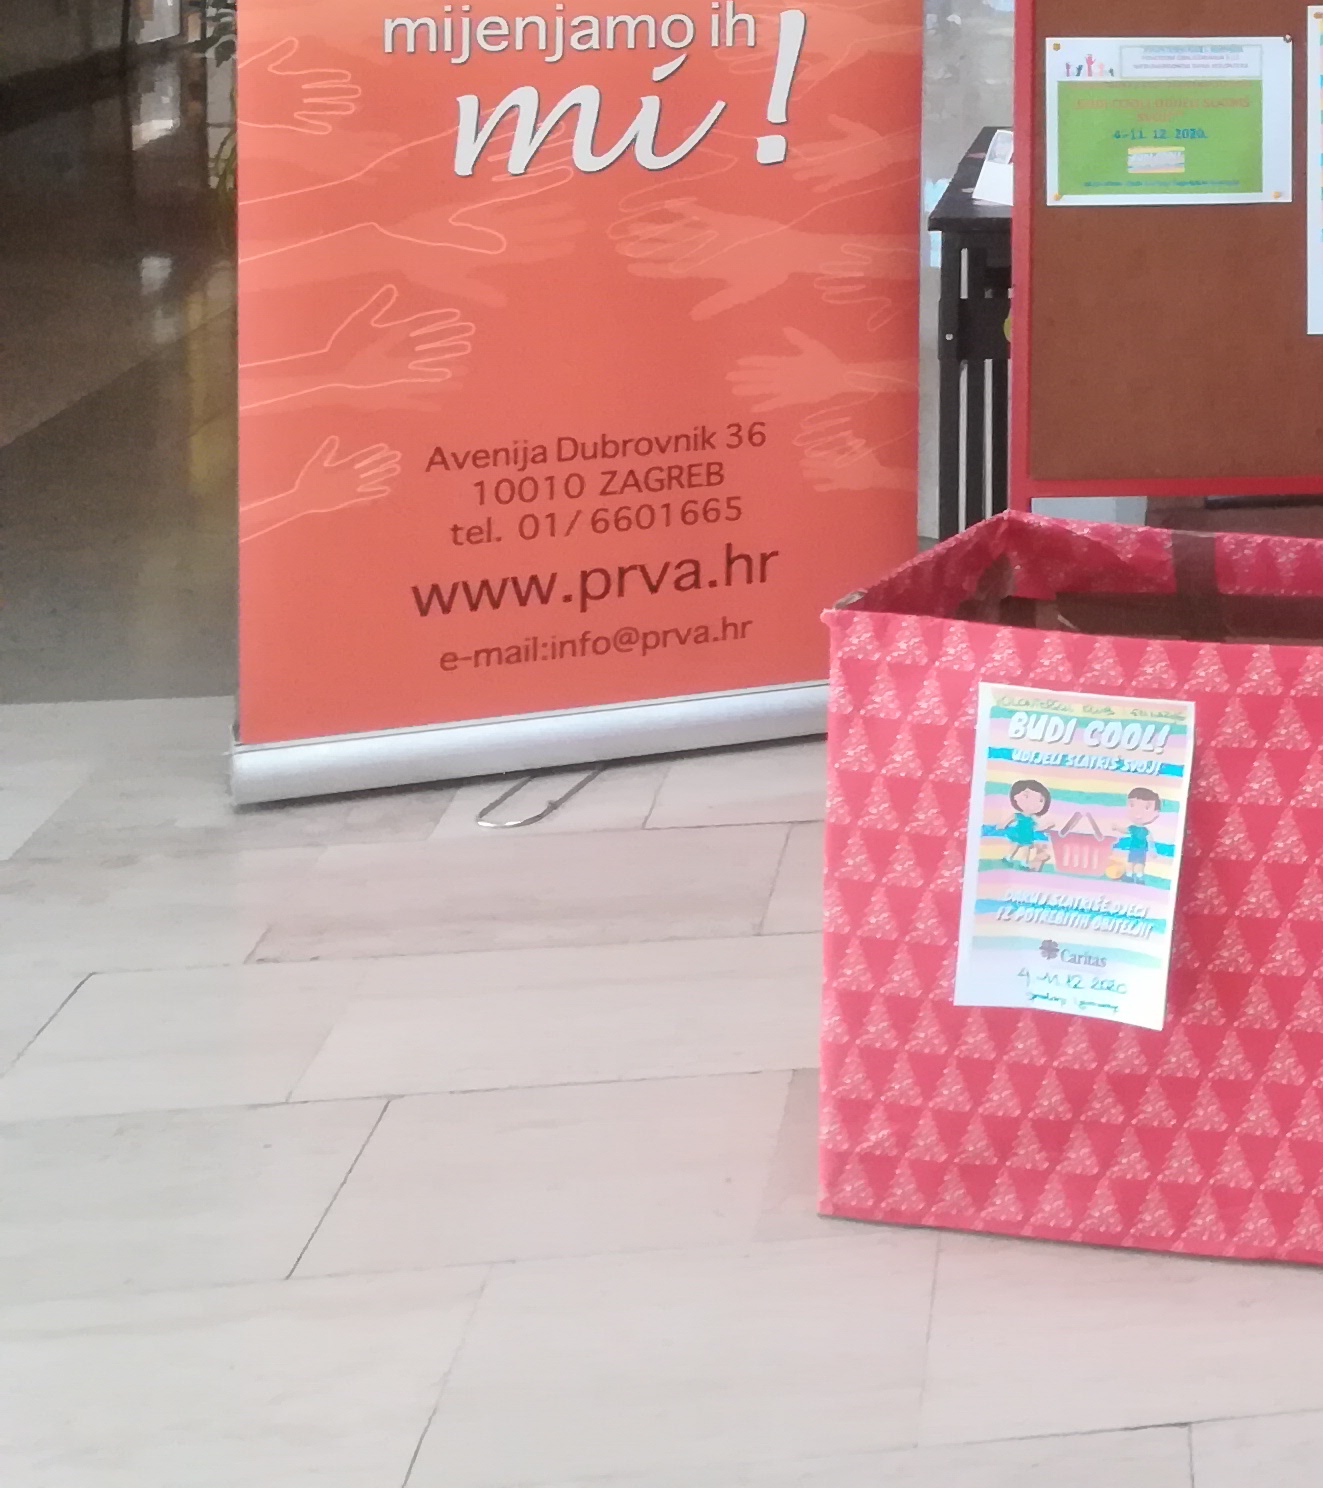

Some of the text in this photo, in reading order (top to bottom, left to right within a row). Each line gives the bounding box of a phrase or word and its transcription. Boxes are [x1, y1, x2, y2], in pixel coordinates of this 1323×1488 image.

[384, 0, 756, 63] mijenjamo ih
[426, 421, 767, 473] Avenija Dubrovnik 36
[474, 461, 725, 506] 10010 ZAGREB
[450, 518, 503, 547] tel.
[411, 543, 780, 618] www.prva.hr
[439, 616, 753, 672] e-mail:info@prva.hr
[1008, 711, 1172, 754] BUDI COOL!
[1060, 947, 1107, 968] Caritas
